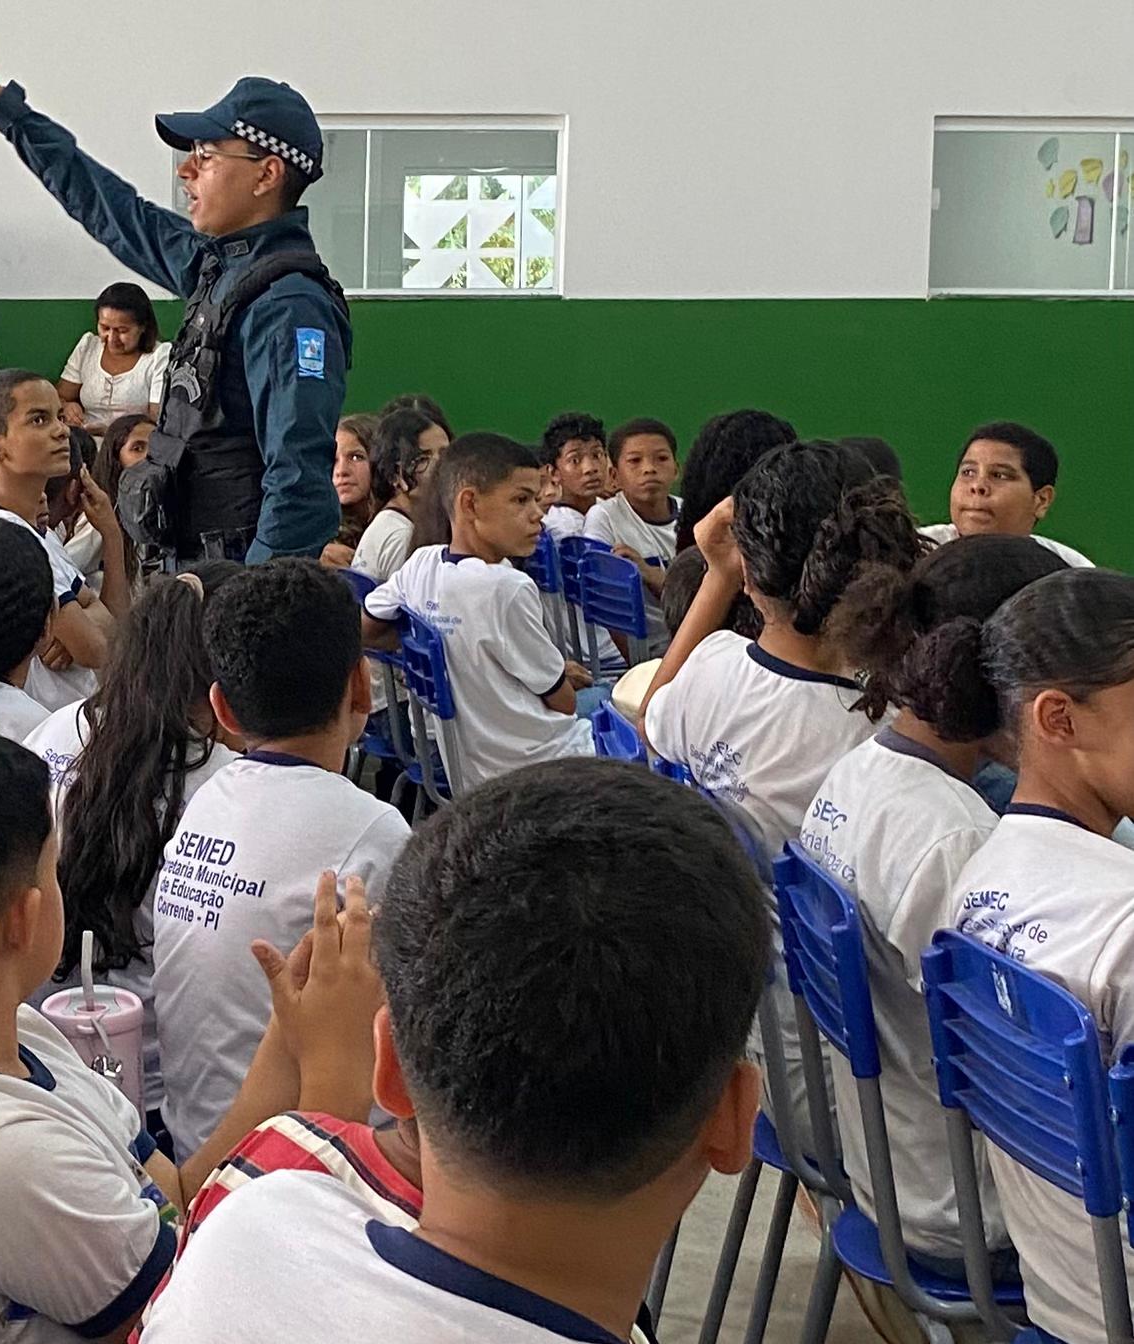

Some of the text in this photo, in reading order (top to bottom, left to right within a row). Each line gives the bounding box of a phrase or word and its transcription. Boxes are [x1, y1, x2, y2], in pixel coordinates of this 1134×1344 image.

[175, 831, 236, 866] SEMED
[170, 878, 225, 909] Educação
[194, 864, 266, 898] Municipal
[157, 895, 194, 922] Corrente
[204, 910, 220, 931] PI
[1028, 923, 1048, 944] de
